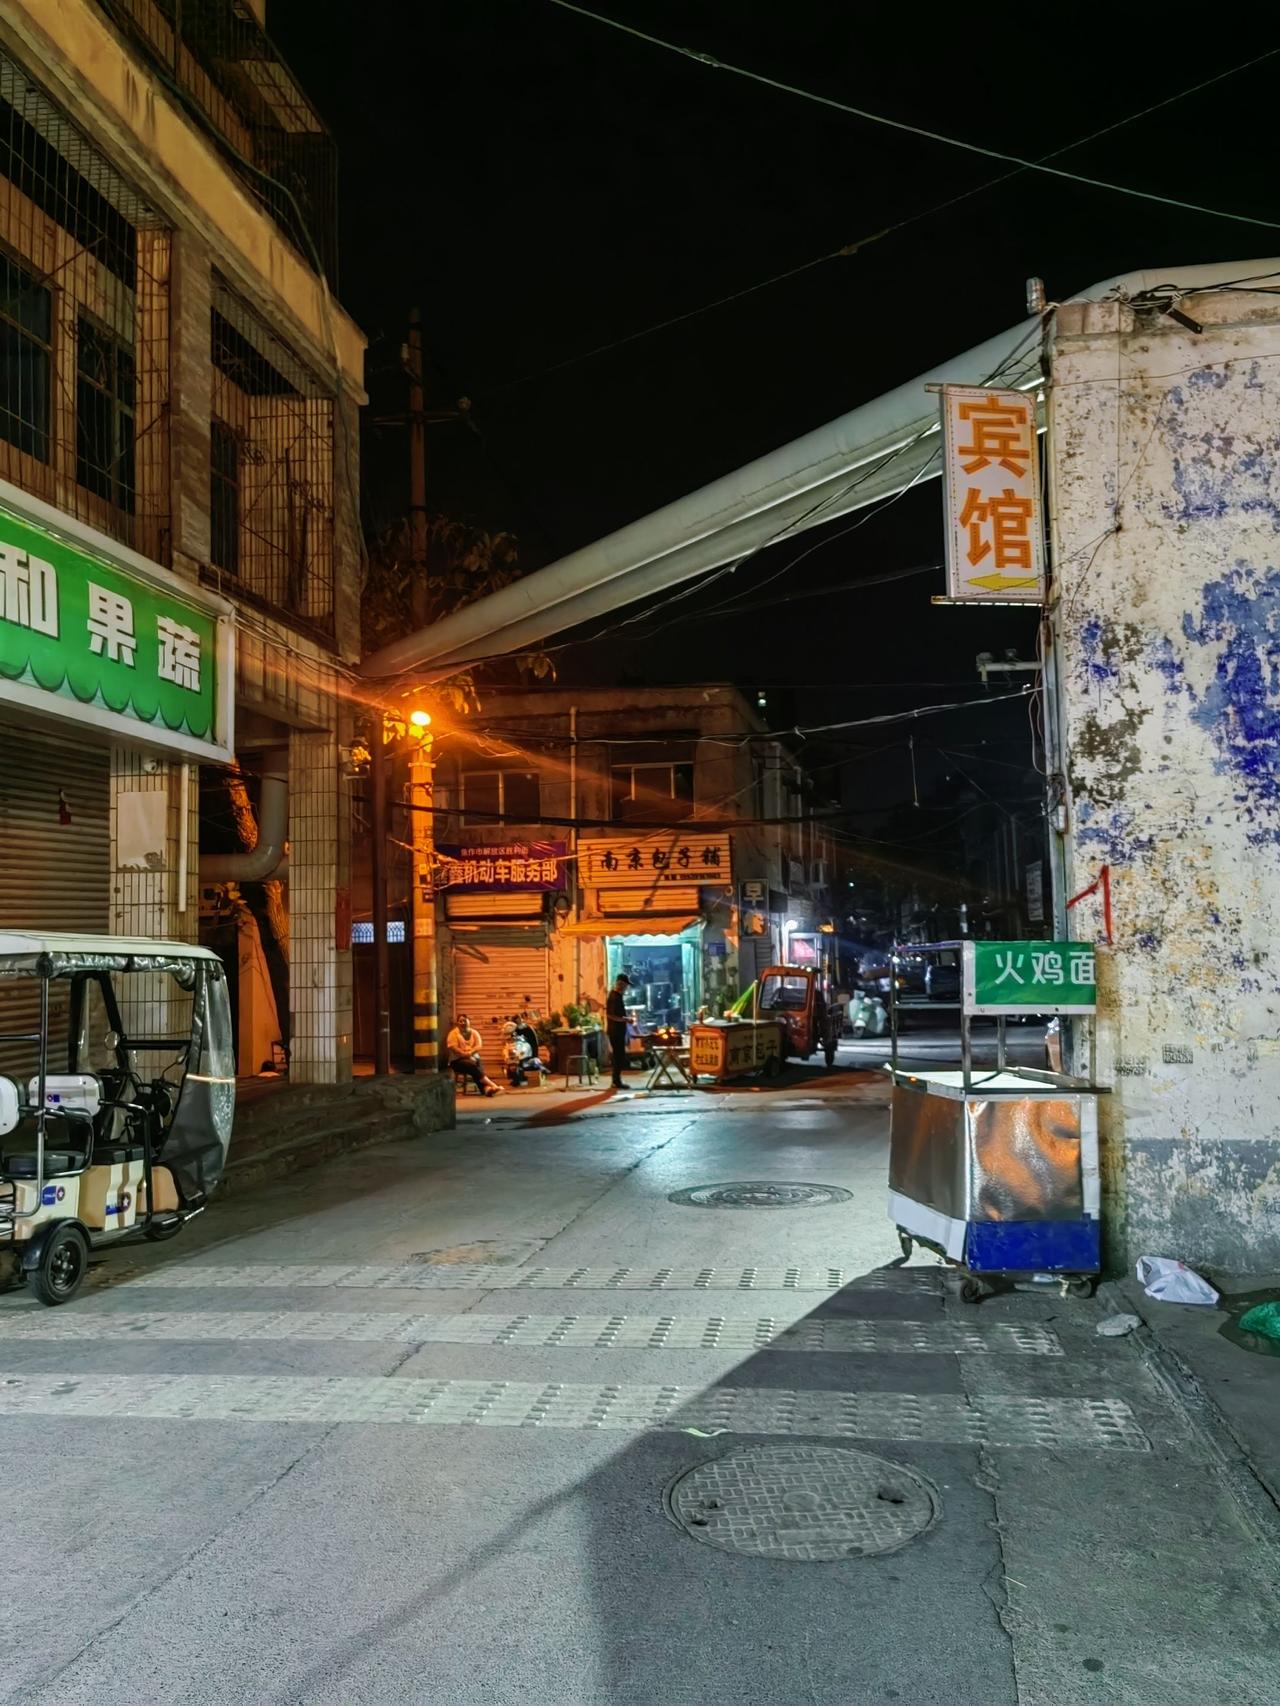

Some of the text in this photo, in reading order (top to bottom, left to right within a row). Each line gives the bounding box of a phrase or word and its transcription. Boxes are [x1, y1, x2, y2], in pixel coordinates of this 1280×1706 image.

[958, 394, 1032, 569] 宾馆
[994, 951, 1096, 985] 火鸡面
